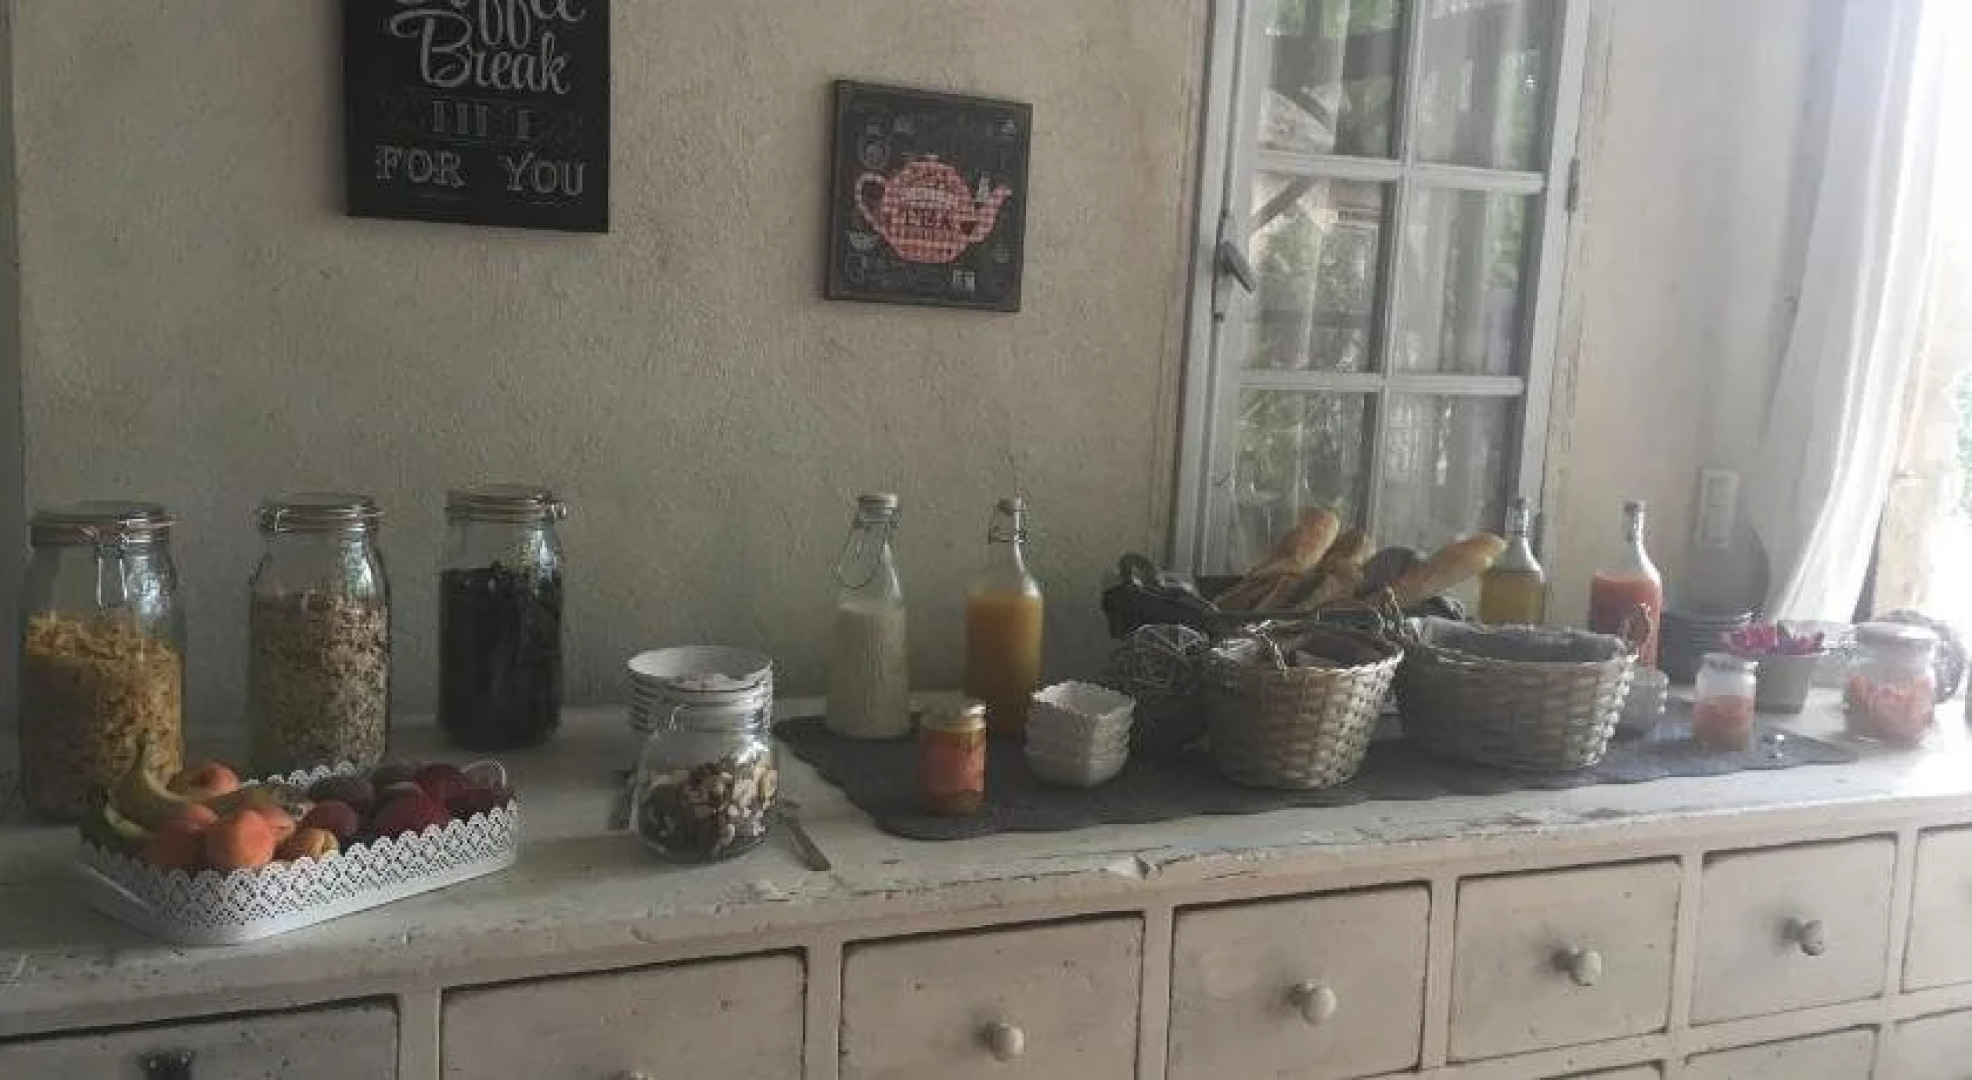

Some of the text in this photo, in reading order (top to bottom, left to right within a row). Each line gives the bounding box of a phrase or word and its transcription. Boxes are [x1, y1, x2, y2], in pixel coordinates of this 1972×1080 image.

[394, 0, 587, 49] ffee
[389, 9, 571, 95] Break
[375, 144, 588, 197] FOR YOU
